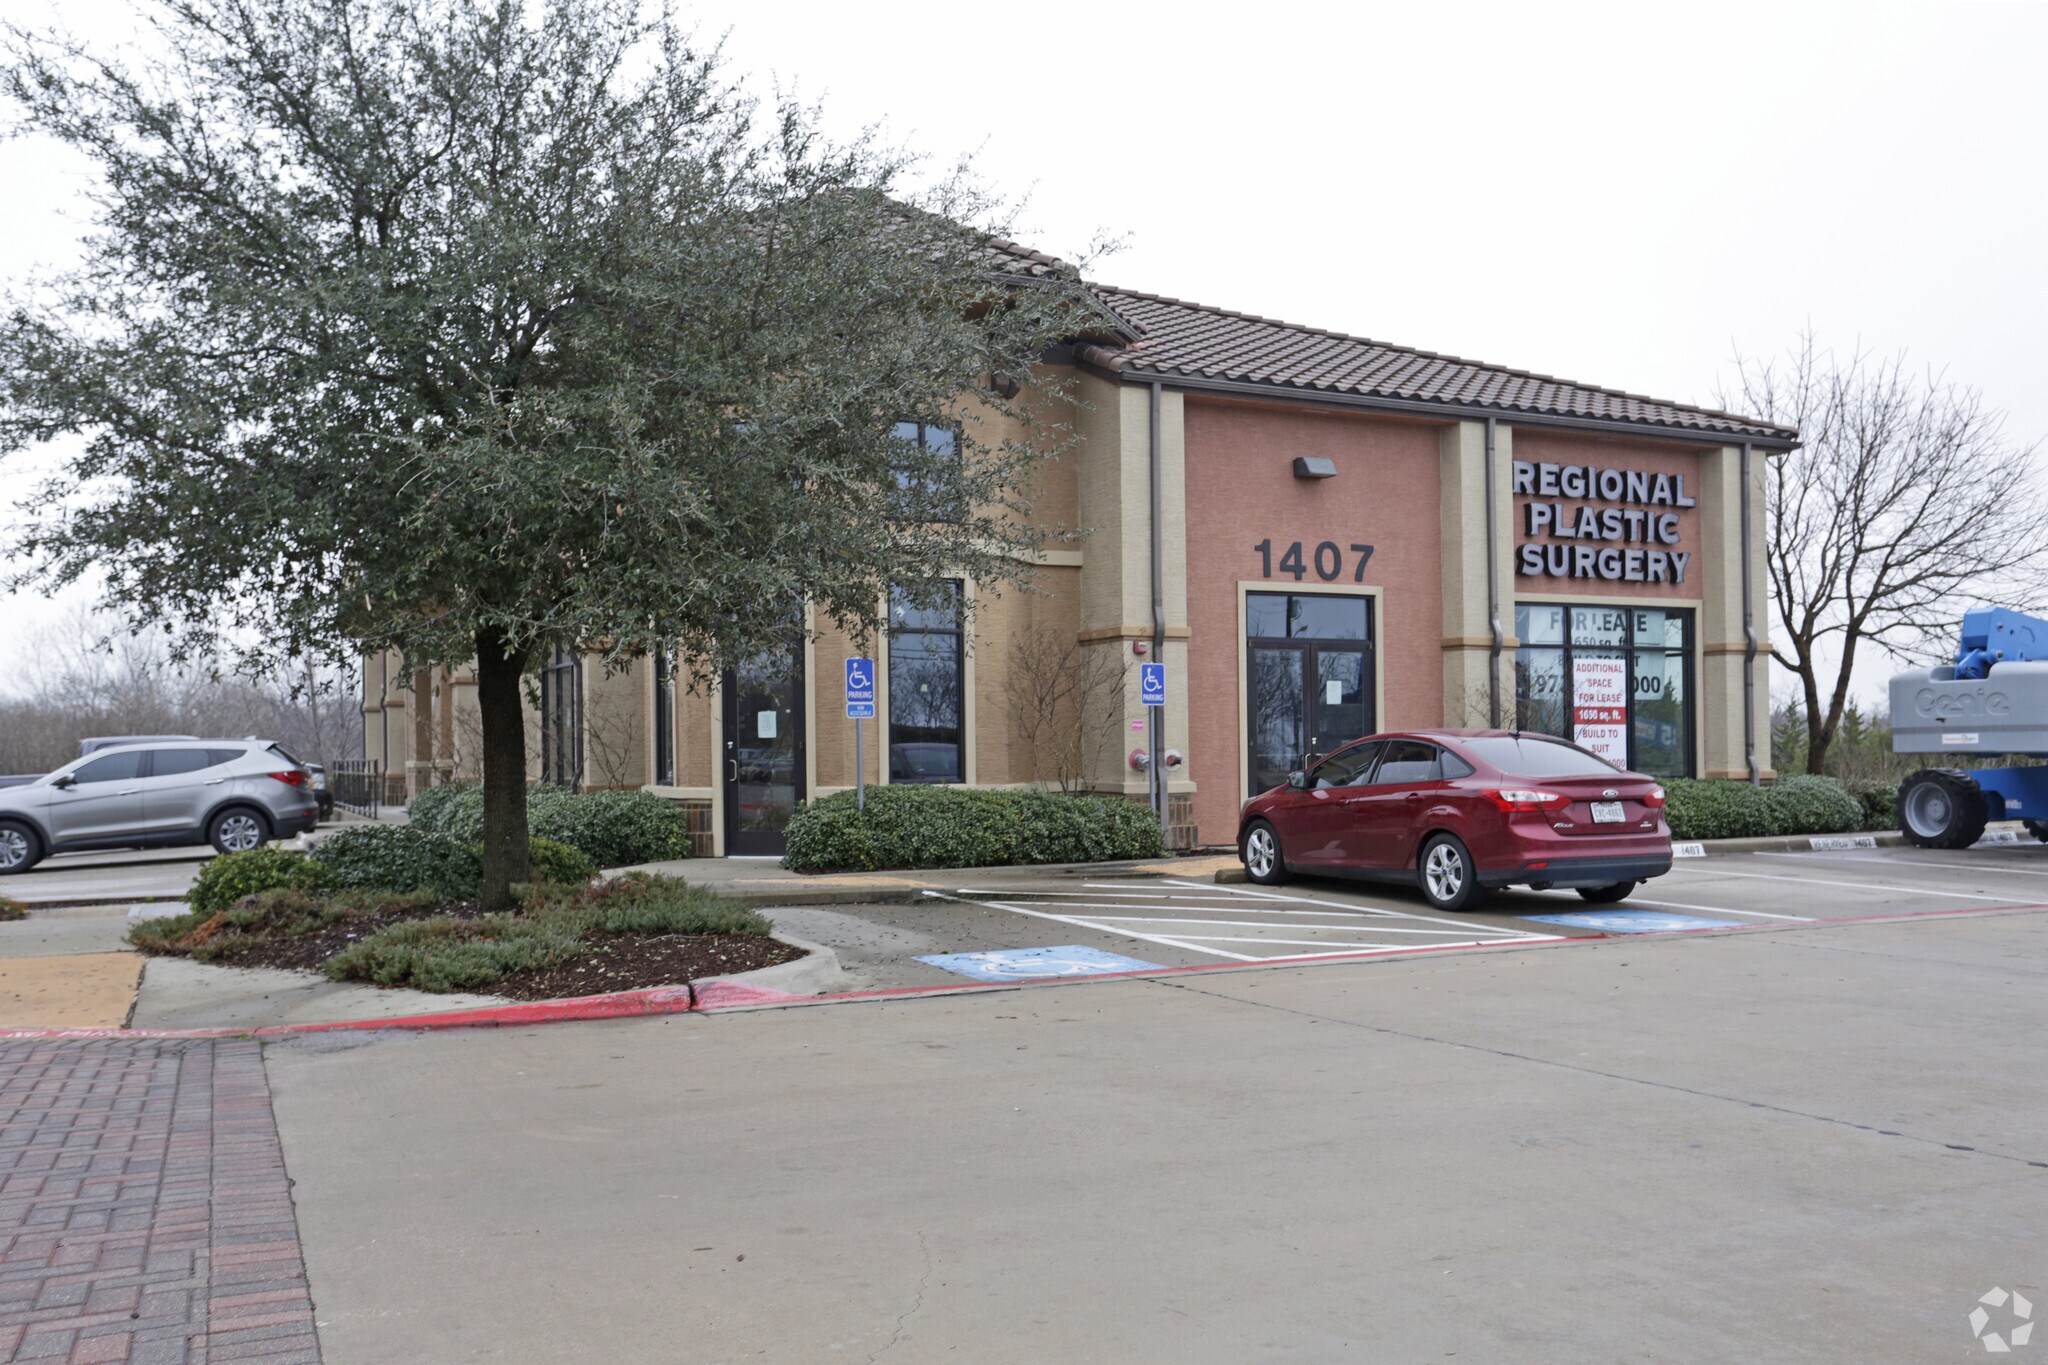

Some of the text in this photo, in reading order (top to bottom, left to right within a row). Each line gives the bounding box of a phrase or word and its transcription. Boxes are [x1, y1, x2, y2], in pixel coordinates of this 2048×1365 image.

[1512, 459, 1697, 508] REGIONAL
[1527, 502, 1681, 545] PLASTIC
[1254, 538, 1374, 582] 1407
[1518, 543, 1691, 584] SURGERY
[1592, 612, 1648, 632] LEAE
[1576, 663, 1623, 673] ADDITIONAL
[1587, 678, 1612, 688] SPACE
[848, 691, 872, 699] PARKING
[1142, 693, 1164, 701] PARKING
[1579, 692, 1621, 703] FOR LEASE
[1579, 709, 1598, 720] 1650
[1582, 729, 1619, 738] BUILD TO
[1591, 744, 1610, 753] SUIT
